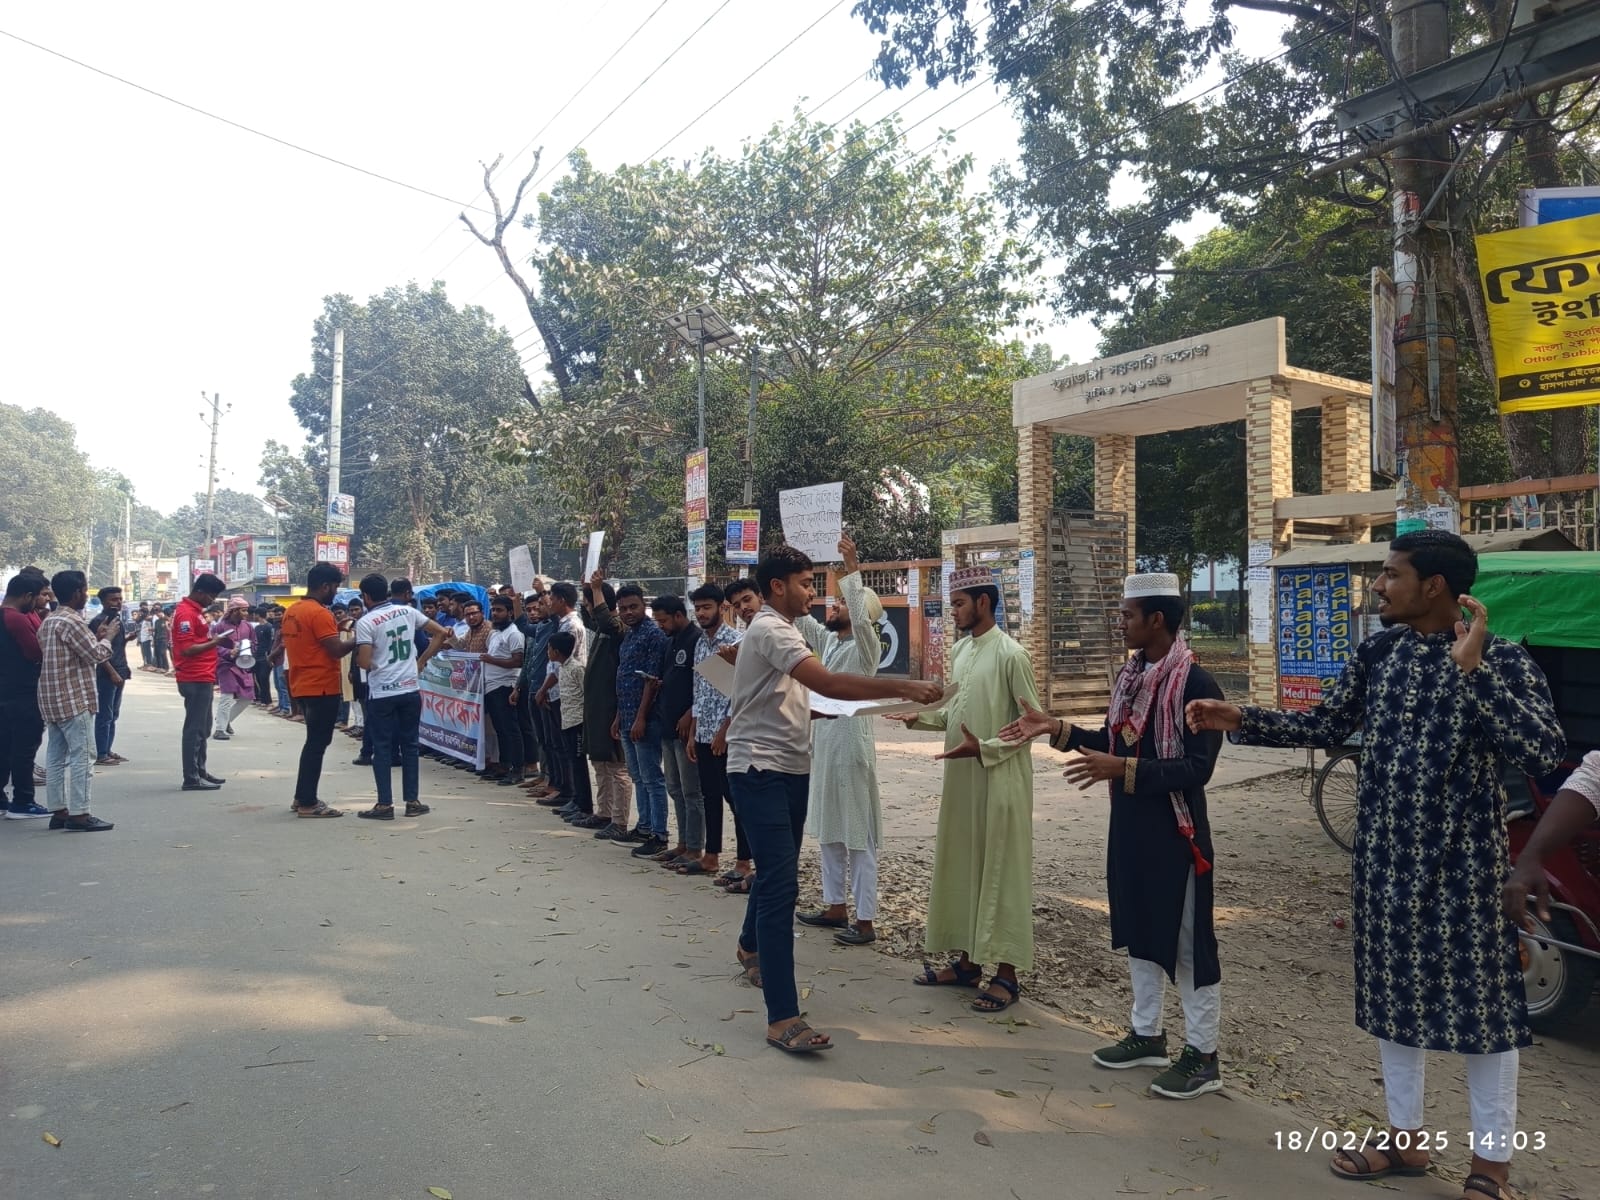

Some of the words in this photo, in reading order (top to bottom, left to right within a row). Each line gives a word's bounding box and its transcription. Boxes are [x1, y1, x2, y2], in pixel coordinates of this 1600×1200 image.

[1106, 352, 1157, 376] সরকারি
[1161, 343, 1210, 364] কলেজ
[1523, 356, 1557, 364] Other
[372, 608, 409, 625] BAYZID
[1295, 574, 1313, 660] Paragon
[1329, 572, 1351, 662] Paragon
[386, 624, 412, 664] 36
[1282, 688, 1306, 699] Medi
